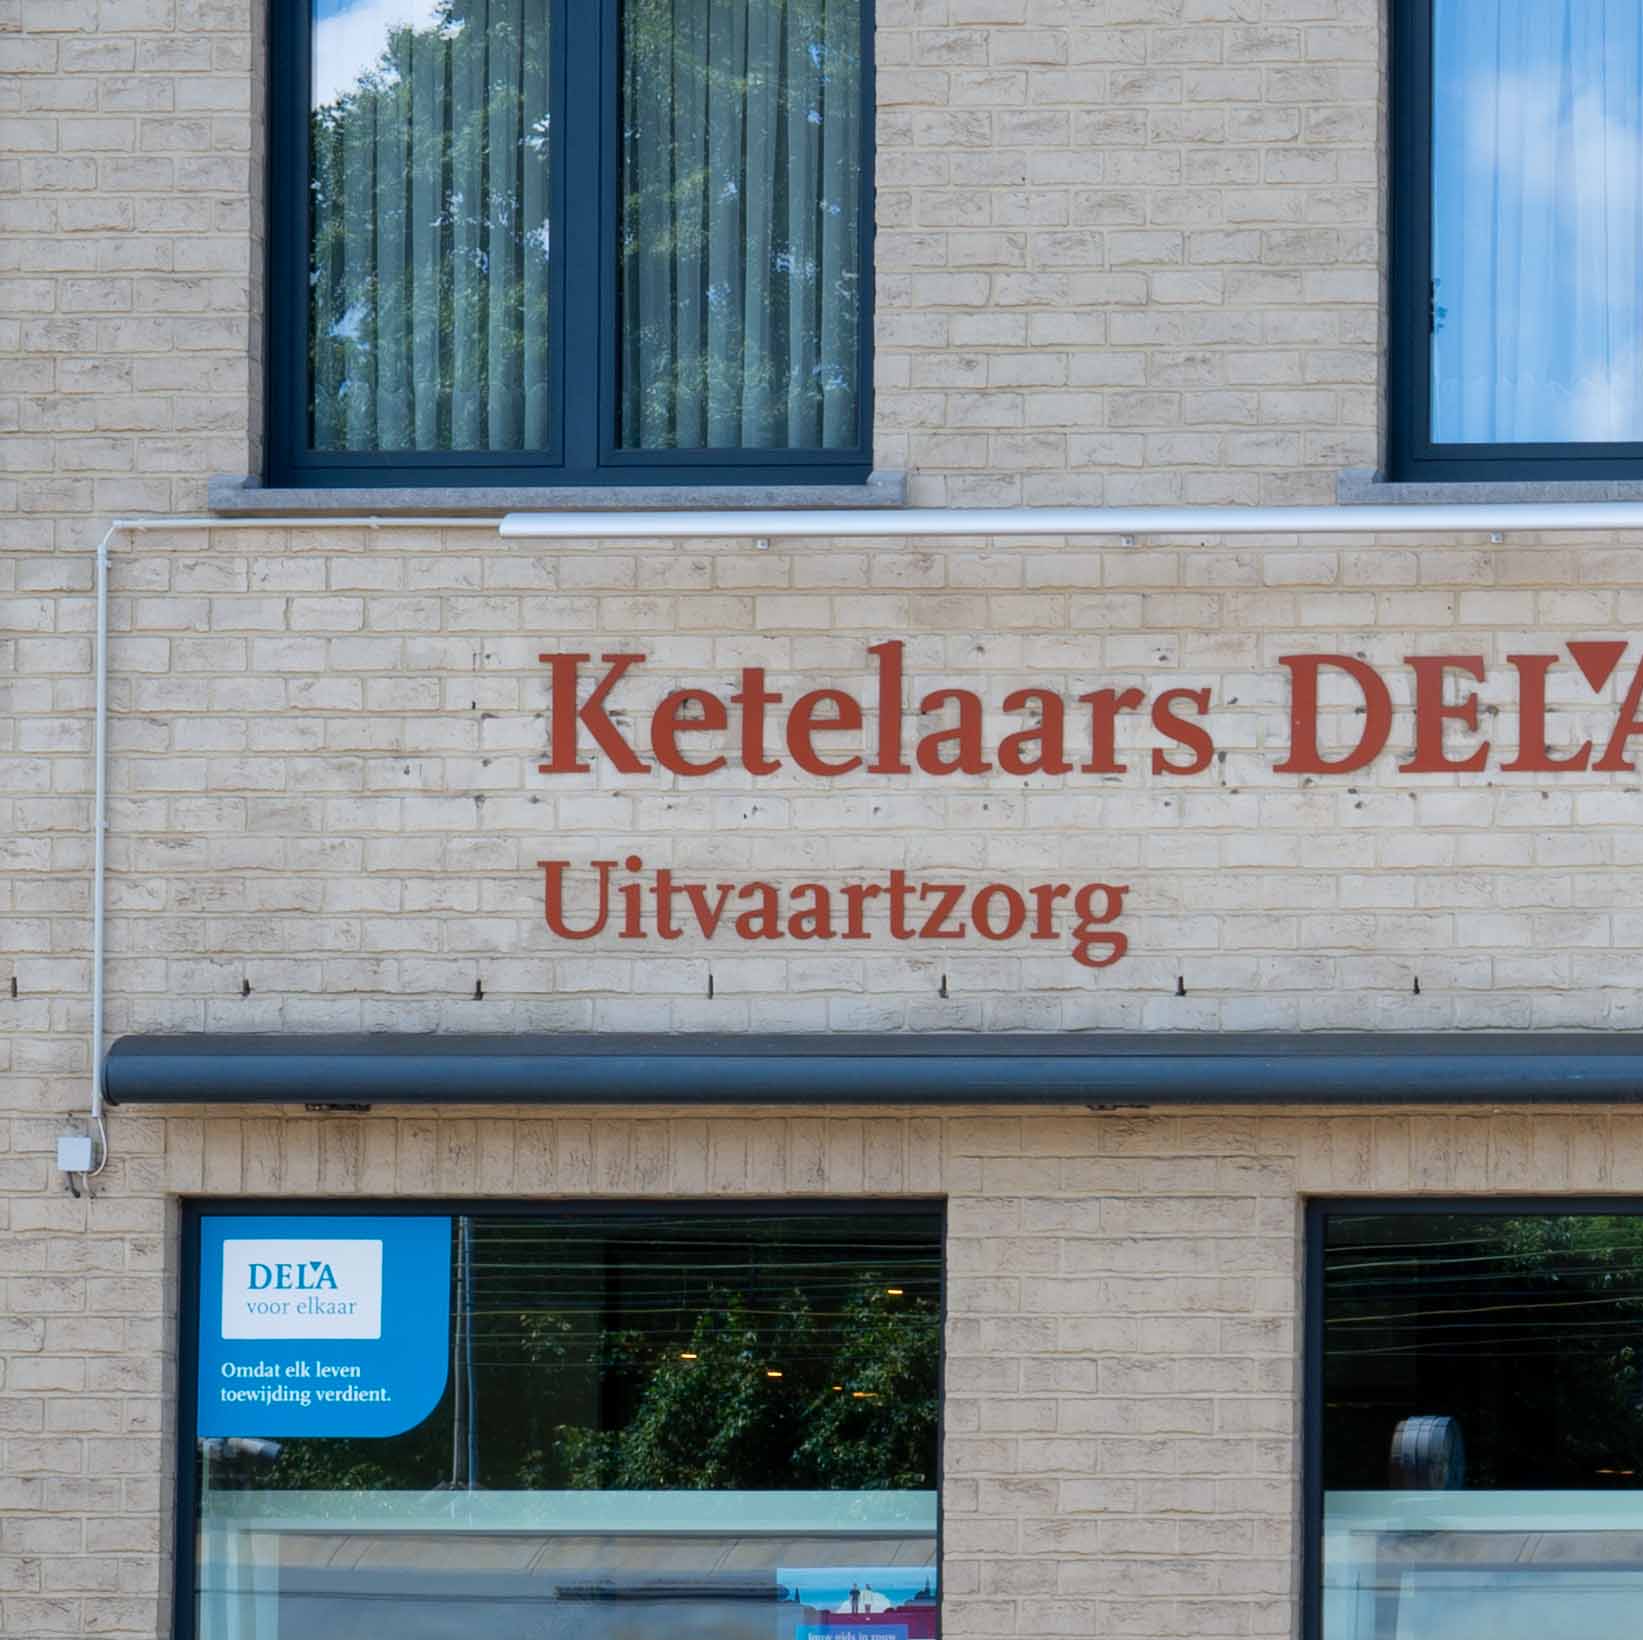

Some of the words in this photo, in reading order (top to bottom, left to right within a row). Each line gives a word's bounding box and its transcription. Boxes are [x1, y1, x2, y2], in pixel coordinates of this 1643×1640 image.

[537, 641, 1213, 776] Ketelaars
[537, 856, 1130, 968] Uitvaartzorg
[247, 1261, 338, 1290] DELA
[247, 1300, 290, 1315] voor
[296, 1296, 357, 1315] elkaar
[221, 1361, 280, 1378] Omdat
[285, 1361, 310, 1378] elk
[316, 1361, 361, 1378] leven
[221, 1385, 311, 1406] toewijding
[316, 1385, 391, 1402] verdient.
